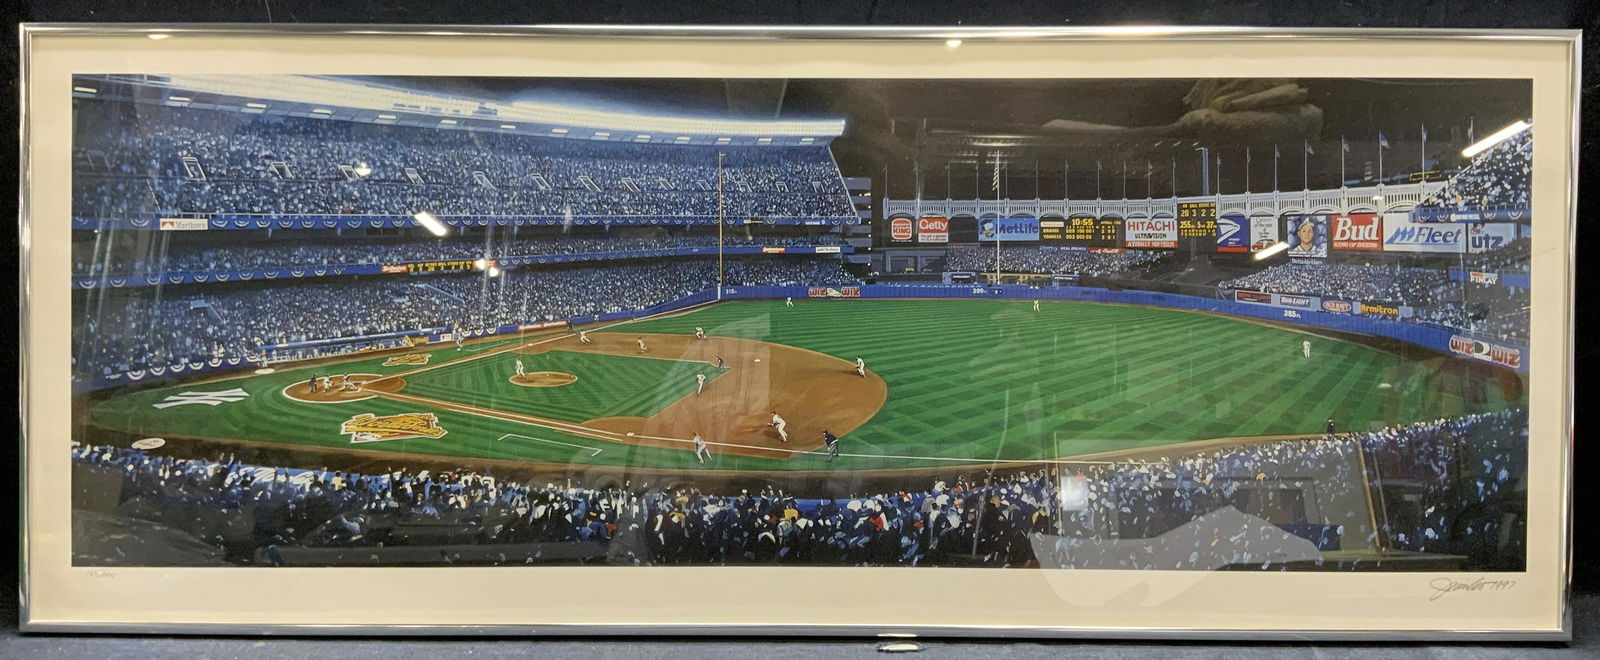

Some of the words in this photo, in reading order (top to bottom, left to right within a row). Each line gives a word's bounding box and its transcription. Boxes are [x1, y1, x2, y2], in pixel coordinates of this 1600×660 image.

[919, 219, 948, 231] Getty
[995, 222, 1039, 234] MetLife
[1127, 220, 1175, 232] HITACHI
[1333, 217, 1379, 241] Bud
[1414, 226, 1462, 243] Fleet
